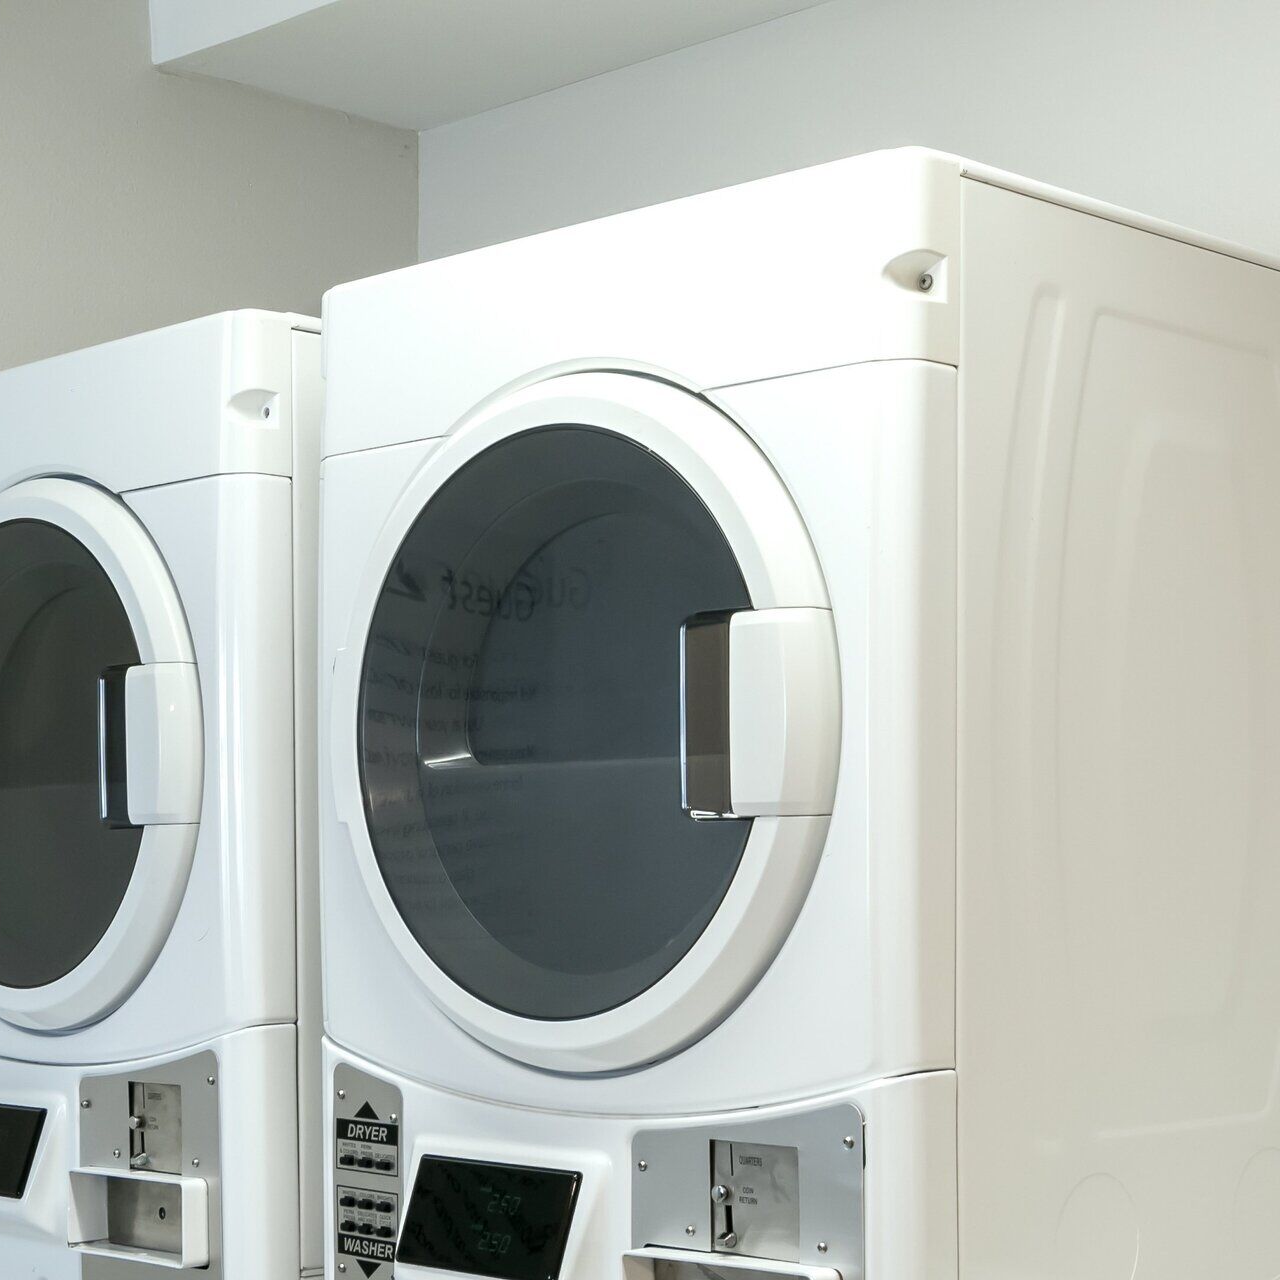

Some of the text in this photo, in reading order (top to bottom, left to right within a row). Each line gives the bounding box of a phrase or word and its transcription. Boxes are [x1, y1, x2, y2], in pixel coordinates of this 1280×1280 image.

[347, 1123, 388, 1142] DRYER
[738, 1154, 763, 1167] QUARTERS
[344, 1237, 394, 1259] WASHER
